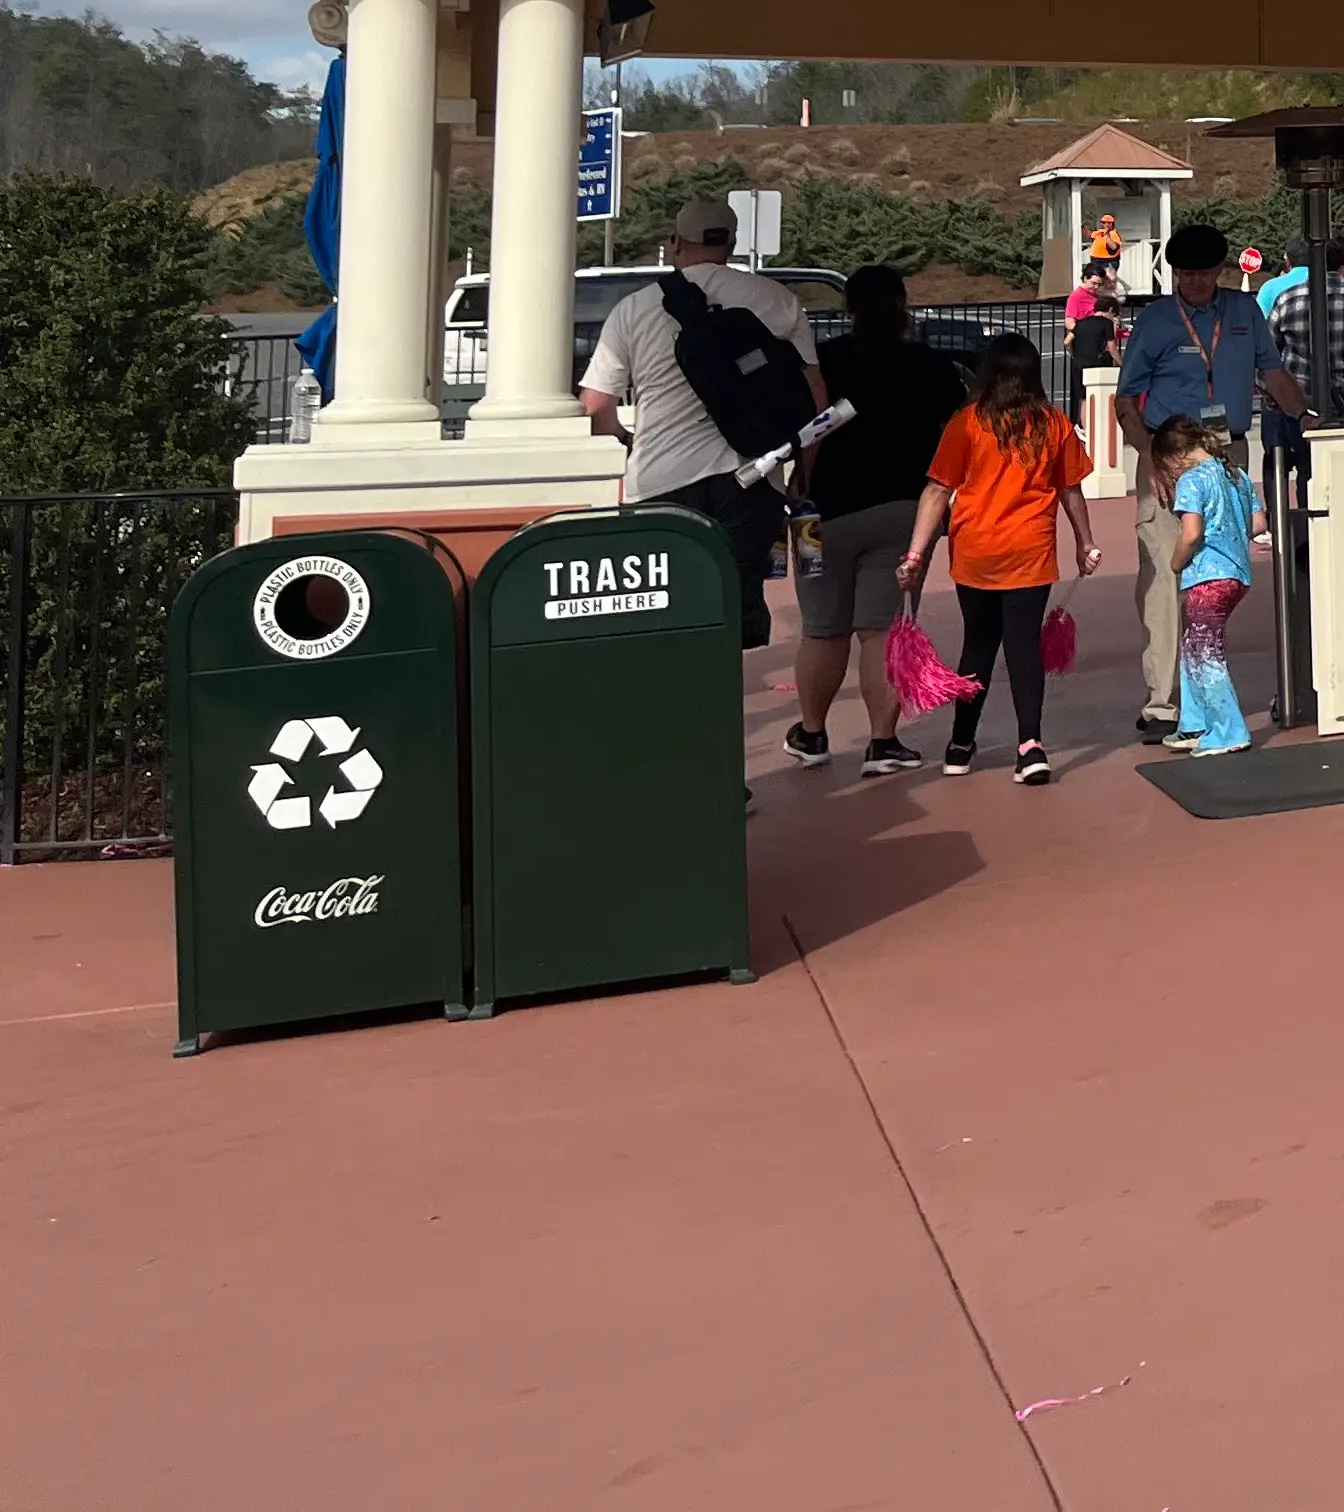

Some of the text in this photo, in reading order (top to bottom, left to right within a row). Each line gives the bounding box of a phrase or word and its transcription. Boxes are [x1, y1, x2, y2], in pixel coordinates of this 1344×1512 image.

[1239, 252, 1262, 268] STOP
[260, 559, 363, 604] PLASTIC BOTTLES ONLY
[544, 553, 668, 596] TRASH
[557, 593, 656, 616] PUSH HERE
[261, 611, 364, 656] PLASTIC BOTTLES ONLY
[255, 875, 385, 927] Coca-Cola
